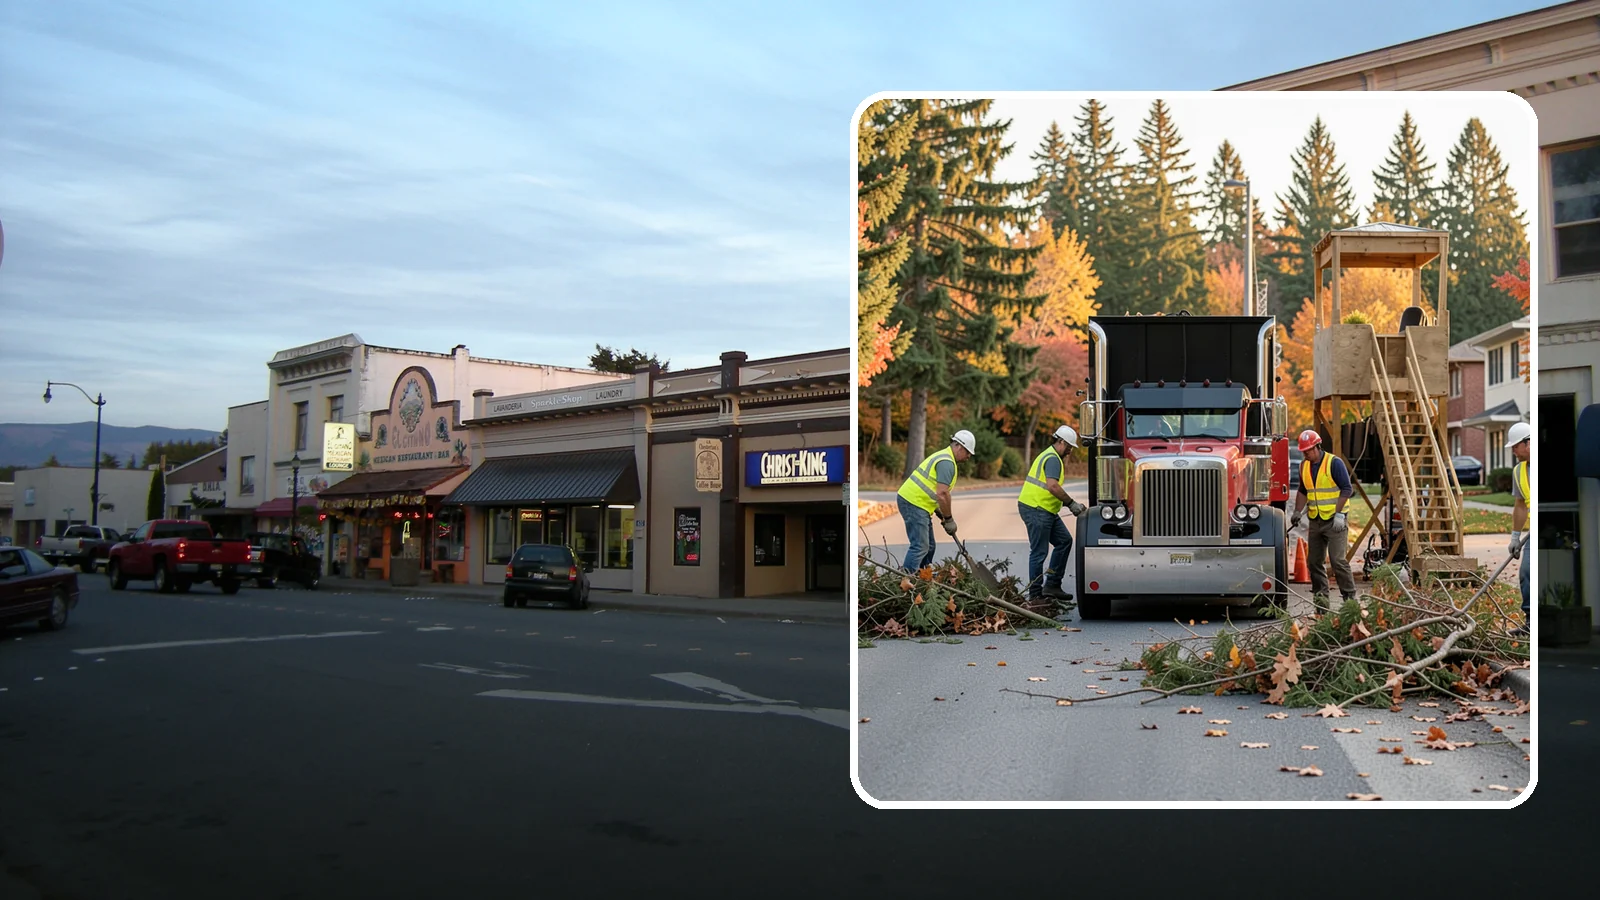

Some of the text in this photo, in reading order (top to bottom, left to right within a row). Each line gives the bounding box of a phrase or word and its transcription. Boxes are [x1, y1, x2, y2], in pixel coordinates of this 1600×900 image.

[530, 394, 582, 409] Sparkle Shop
[596, 389, 623, 400] LAUNDRY
[494, 402, 522, 412] LAVANDERIA
[374, 454, 396, 464] MEXICAN
[398, 451, 433, 462] RESTAURANT
[438, 450, 450, 459] BAR
[799, 450, 828, 476] KING
